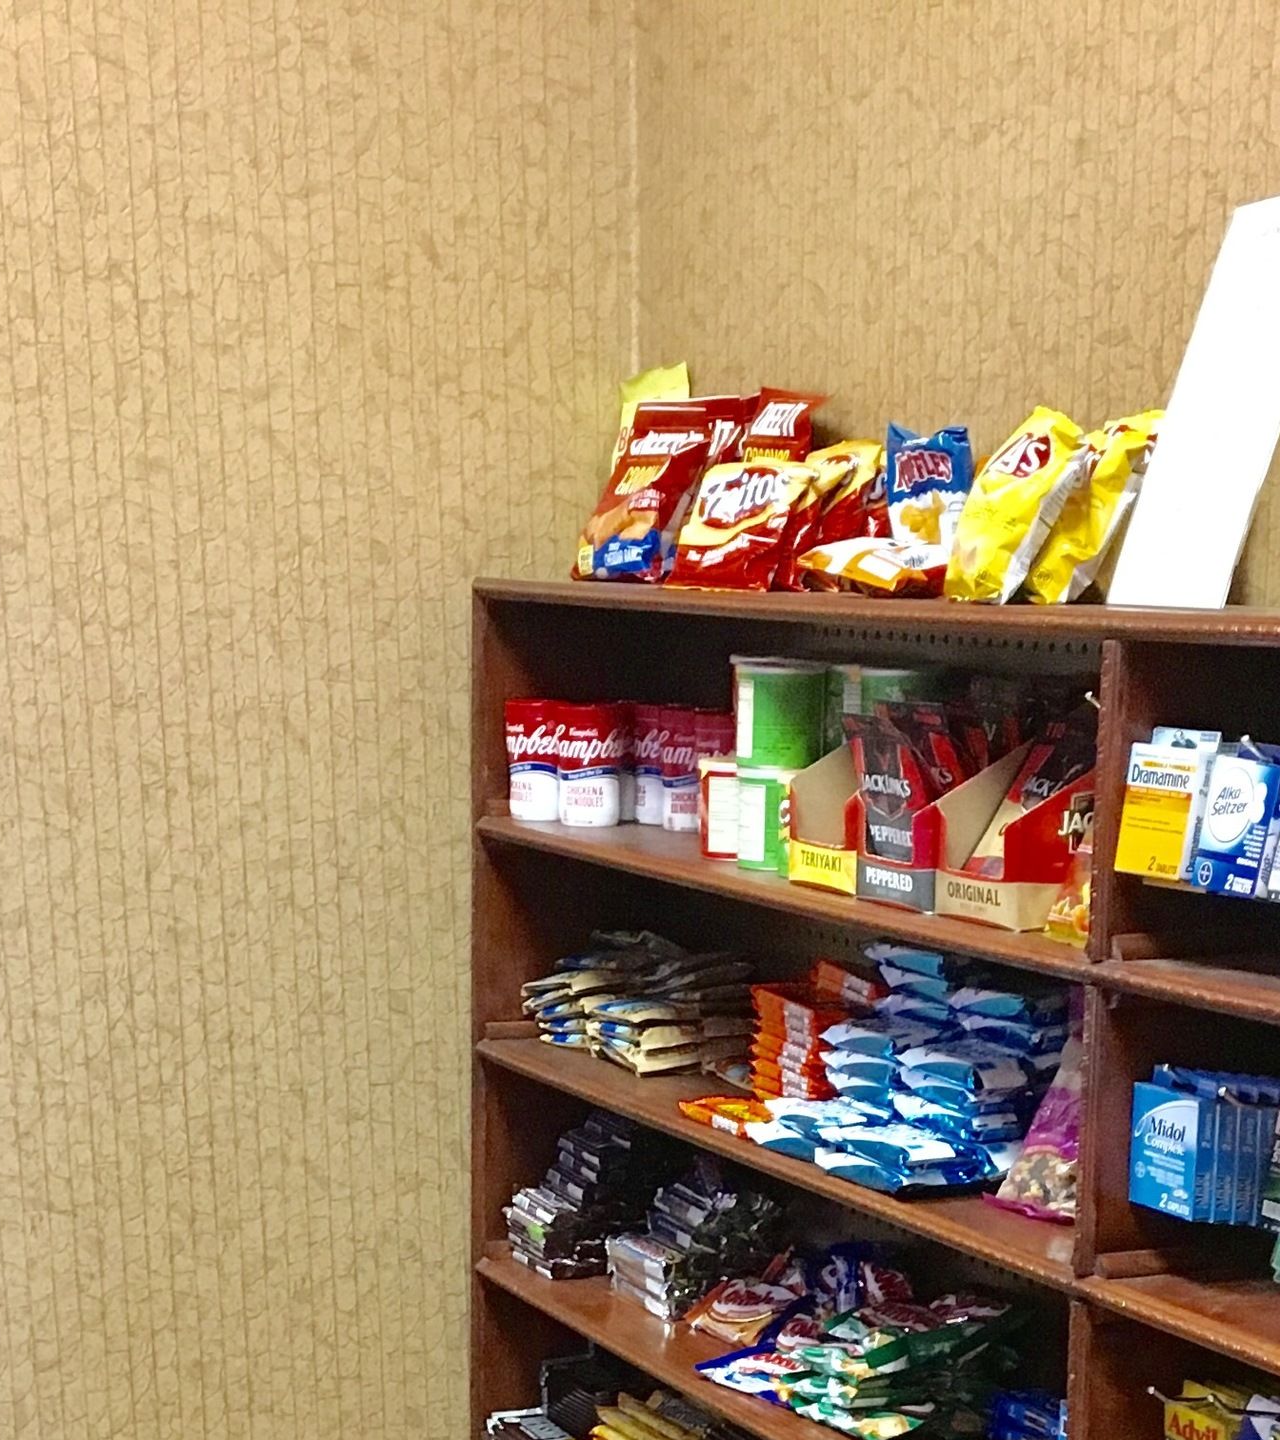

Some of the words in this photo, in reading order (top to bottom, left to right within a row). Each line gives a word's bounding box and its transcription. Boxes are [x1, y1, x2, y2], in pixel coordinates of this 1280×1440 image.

[1131, 764, 1190, 789] Dramamine
[1211, 801, 1249, 817] Seltzer
[801, 850, 842, 873] TERIYAKI
[1147, 856, 1157, 872] 2
[865, 866, 913, 893] PEPPERED
[1224, 873, 1234, 890] 2
[947, 881, 1001, 908] ORIGINAL
[1150, 1116, 1186, 1143] Midol
[1159, 1192, 1169, 1208] 2
